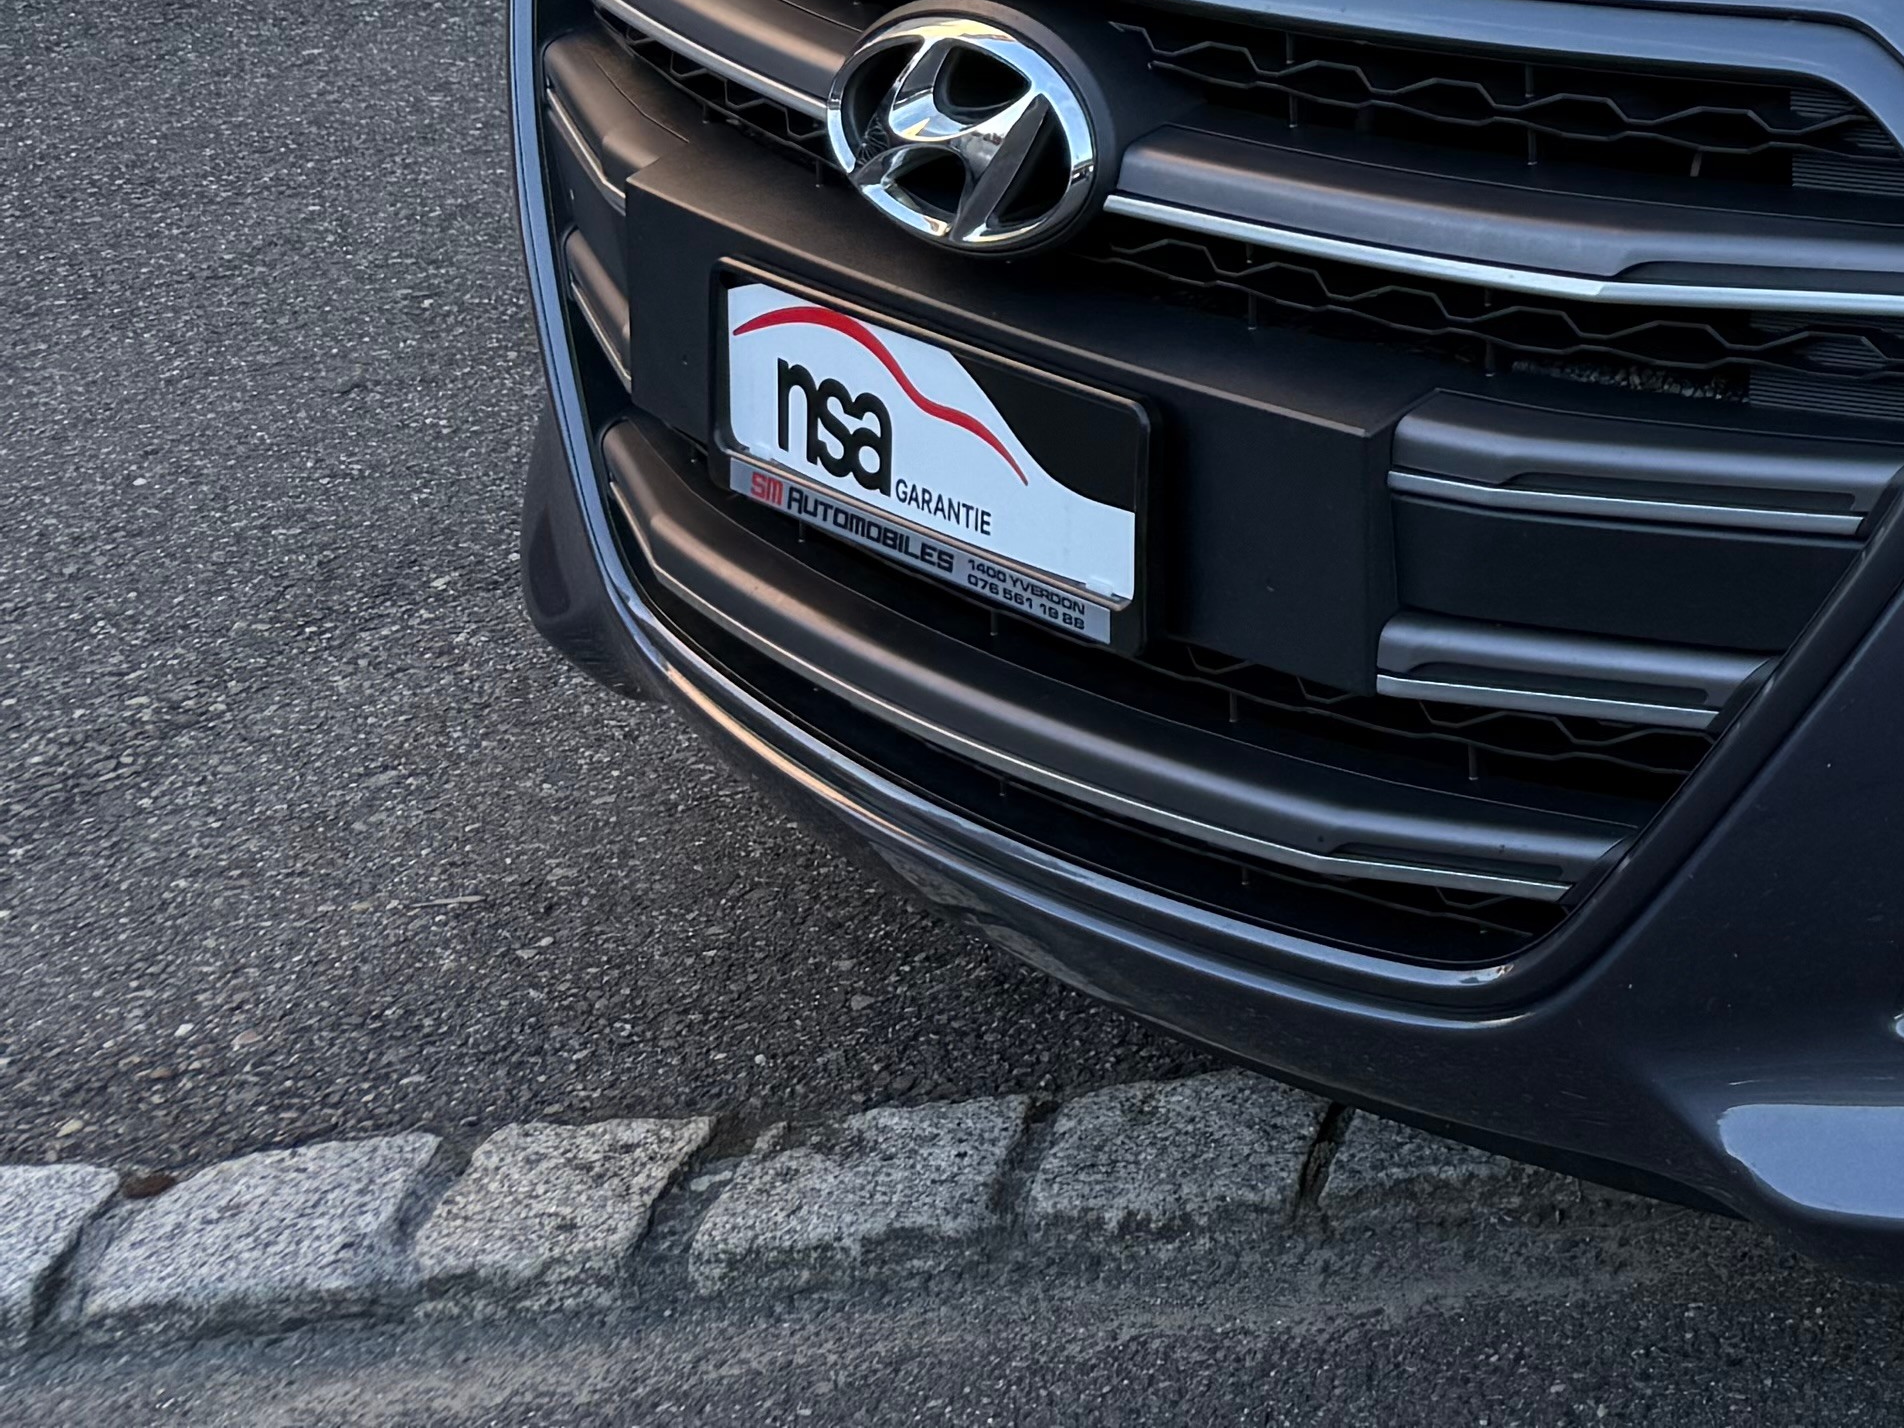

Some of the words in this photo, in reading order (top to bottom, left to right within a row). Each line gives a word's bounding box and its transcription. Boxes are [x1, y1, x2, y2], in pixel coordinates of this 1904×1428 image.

[777, 357, 893, 498] nsa
[750, 471, 784, 506] SM
[787, 486, 955, 574] AUTOMOBILES
[895, 478, 992, 536] GARANTIE
[967, 573, 1000, 596] 076
[1003, 587, 1033, 610] 561
[968, 559, 1007, 584] 1400
[1009, 574, 1086, 616] YVERDON
